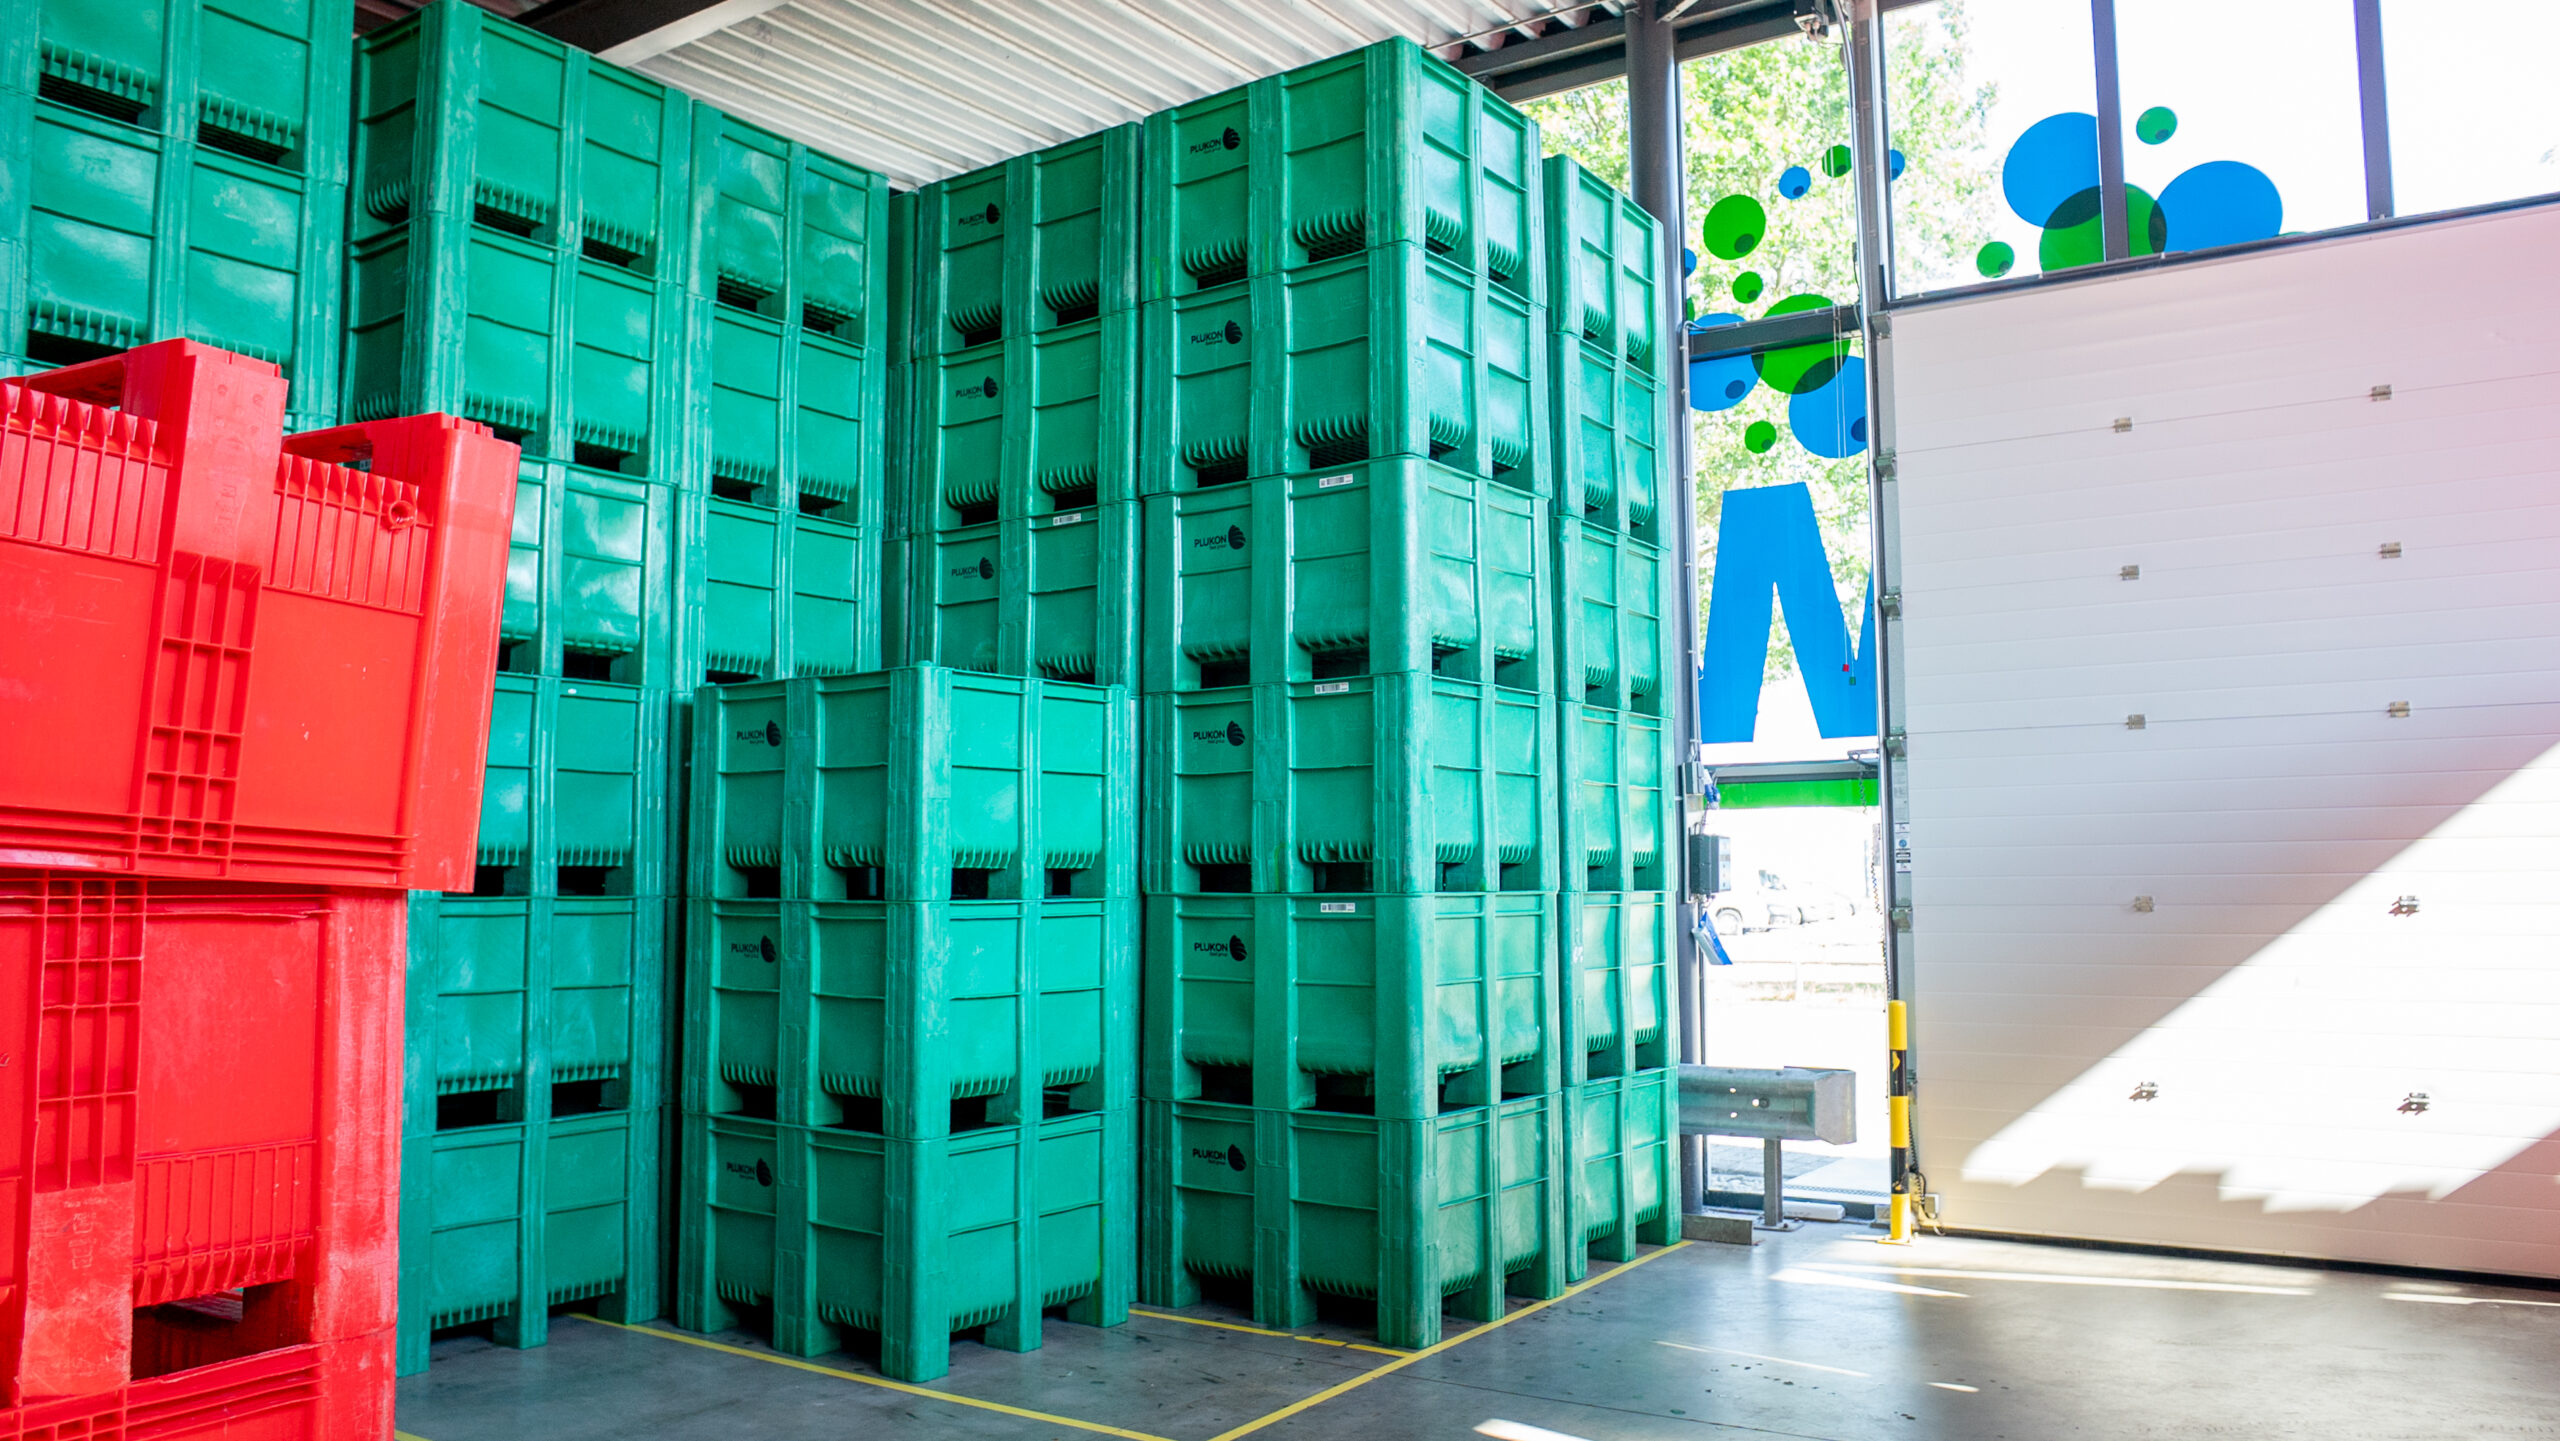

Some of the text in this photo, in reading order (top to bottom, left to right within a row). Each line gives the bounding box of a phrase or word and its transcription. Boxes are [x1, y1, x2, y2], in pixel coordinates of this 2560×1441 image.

[1191, 138, 1221, 154] PLUKON
[1191, 330, 1223, 344] PLUKON
[1194, 535, 1226, 547] PLUKON
[951, 566, 978, 576] PLUKON
[737, 729, 764, 740] PLUKON
[1193, 730, 1225, 740] PLUKON
[731, 943, 759, 953] PLUKON
[1194, 942, 1228, 952] PLUKON
[1192, 1148, 1226, 1160] PLUKON
